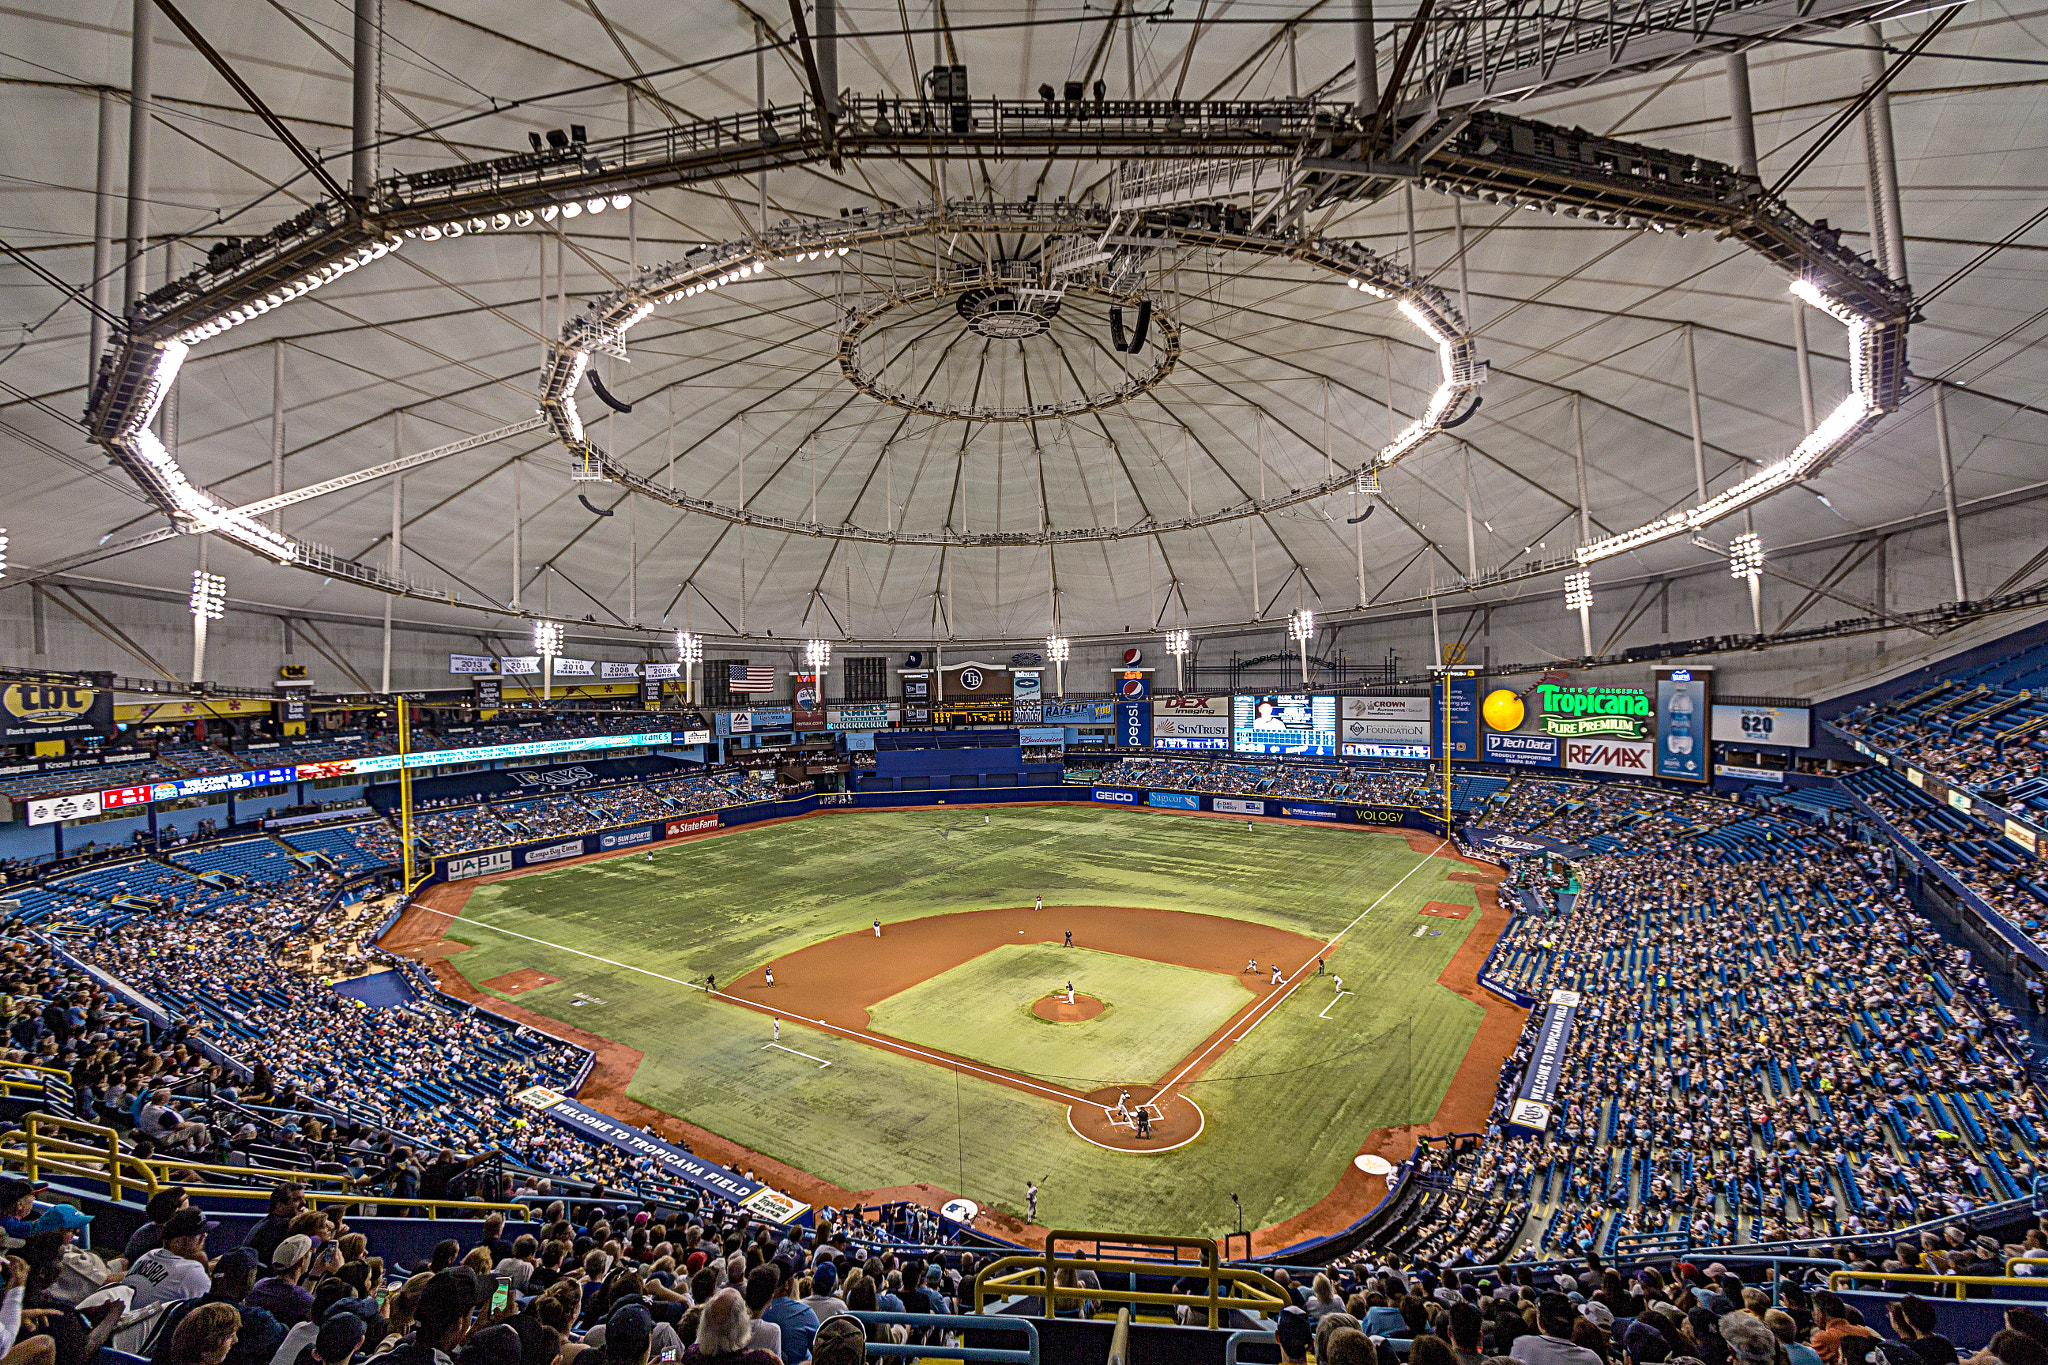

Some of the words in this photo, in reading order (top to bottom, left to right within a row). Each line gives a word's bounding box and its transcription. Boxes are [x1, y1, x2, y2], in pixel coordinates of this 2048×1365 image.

[965, 672, 979, 686] TB
[16, 677, 83, 710] tbt
[1537, 684, 1649, 716] Tropicana
[1164, 695, 1209, 708] DEX
[1046, 705, 1071, 716] RAYS
[1075, 703, 1088, 713] UP
[1095, 706, 1111, 716] YOU
[6, 727, 24, 735] Fast
[48, 726, 62, 734] you
[1126, 704, 1141, 746] pepsi
[1366, 725, 1423, 735] FOUNDATION
[1547, 720, 1577, 733] PURE
[1579, 719, 1633, 732] PREMIUM
[1741, 715, 1773, 733] 620
[1021, 735, 1063, 744] Budweiser
[1502, 737, 1524, 748] Tech
[1526, 739, 1552, 750] Data
[1568, 744, 1647, 769] RE/MAX
[45, 761, 71, 769] Know
[184, 775, 229, 788] WELCOME
[230, 773, 243, 781] TO
[507, 766, 594, 787] RAYS
[179, 782, 227, 796] TROPICANA
[227, 779, 250, 789] FIELD
[1096, 791, 1133, 801] GEICO
[1151, 792, 1182, 804] Sagicor
[1356, 809, 1404, 822] VOLOGY
[618, 835, 628, 843] SUN
[629, 830, 651, 841] SPORTS
[530, 850, 549, 859] Tampa
[550, 847, 560, 856] Bay
[561, 843, 578, 853] Times
[450, 853, 511, 873] JABIL
[1553, 1004, 1568, 1021] FIELD
[1544, 1021, 1564, 1055] TROPICANA
[1541, 1054, 1554, 1065] TO
[1530, 1065, 1552, 1101] WELCOME
[554, 1102, 613, 1132] WELCOME
[610, 1128, 630, 1140] TO
[628, 1136, 705, 1176] TROPICANA
[703, 1172, 750, 1196] FIELD
